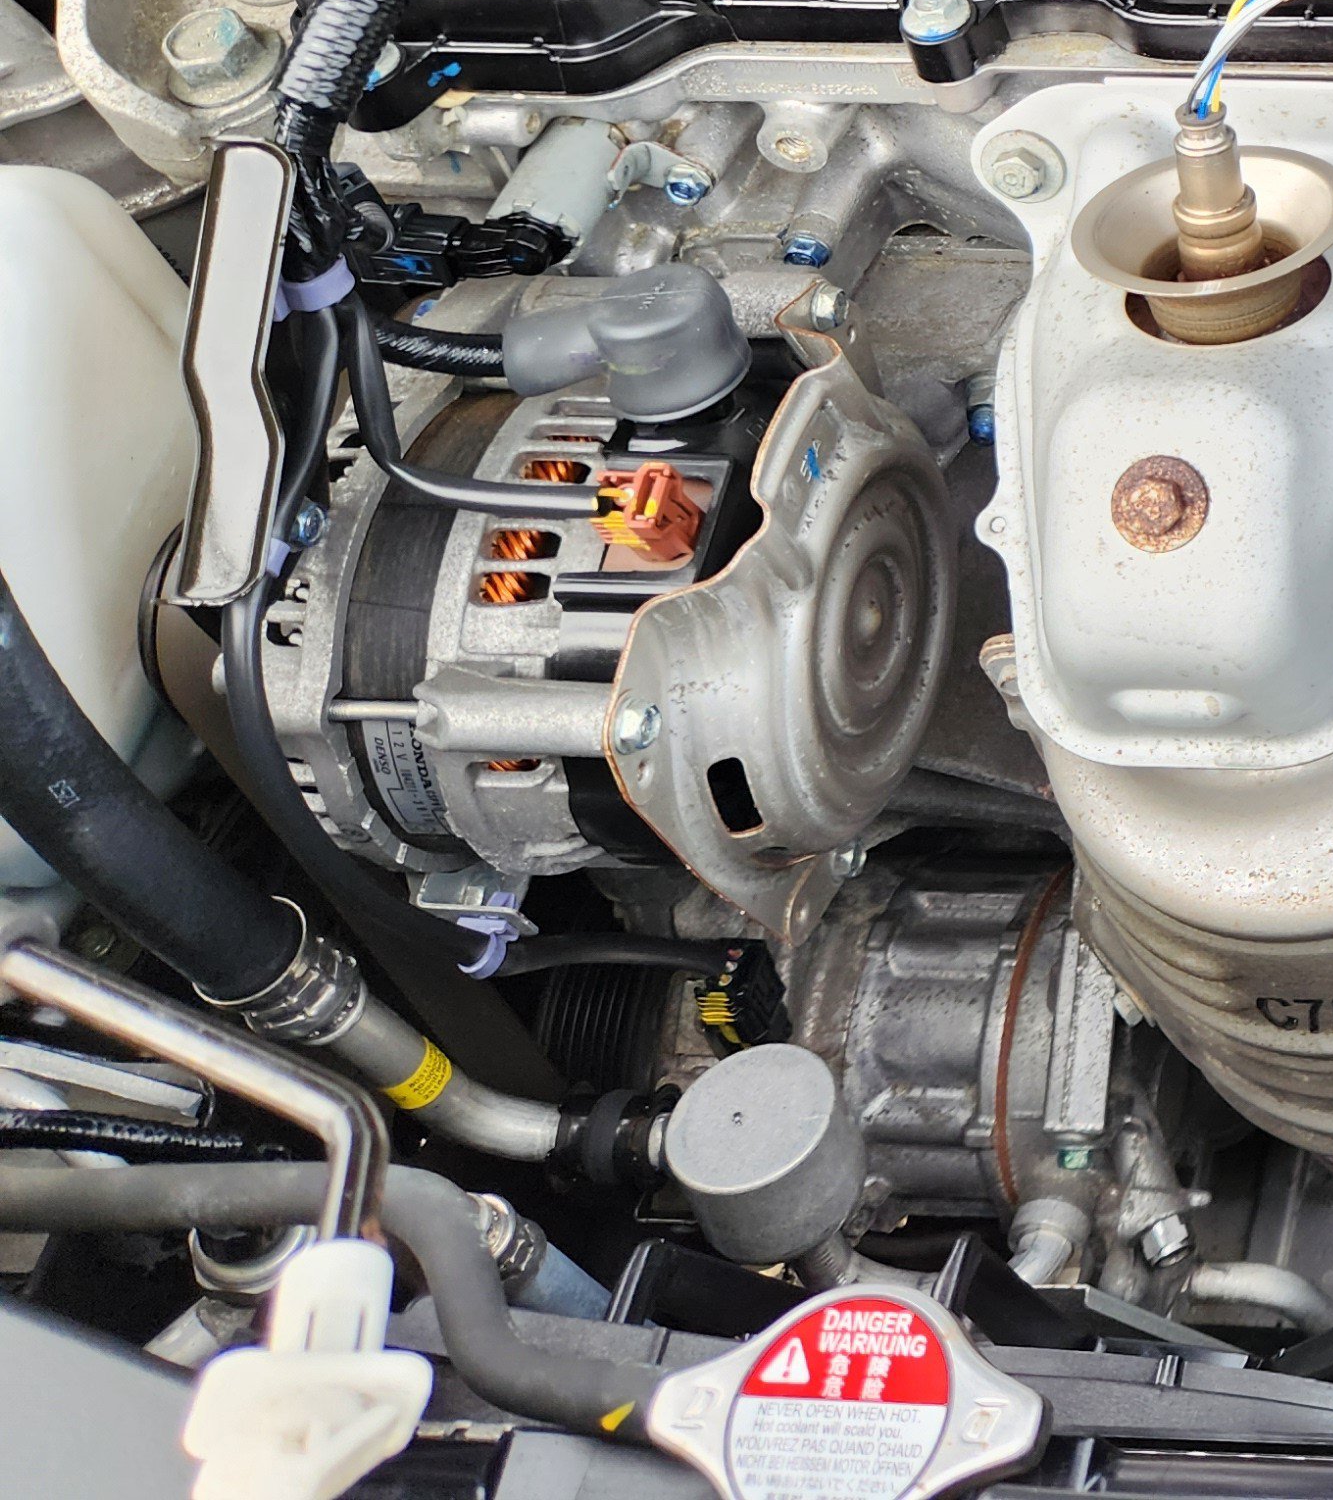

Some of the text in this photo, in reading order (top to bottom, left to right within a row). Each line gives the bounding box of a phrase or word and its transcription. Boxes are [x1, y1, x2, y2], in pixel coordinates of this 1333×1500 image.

[375, 736, 392, 775] DENSO
[822, 1307, 914, 1334] DANGER
[818, 1331, 928, 1358] WARNUNG
[757, 1403, 921, 1424] NEVER OPEN WHEN HOT.
[753, 1419, 773, 1432] Hot
[776, 1422, 818, 1434] coolant
[823, 1422, 841, 1435] will
[845, 1423, 875, 1437] scald
[801, 1438, 826, 1453] PAS
[829, 1440, 875, 1456] QUAND
[736, 1454, 766, 1468] NICHT
[768, 1455, 785, 1469] BEI
[833, 1458, 870, 1474] MOTOR
